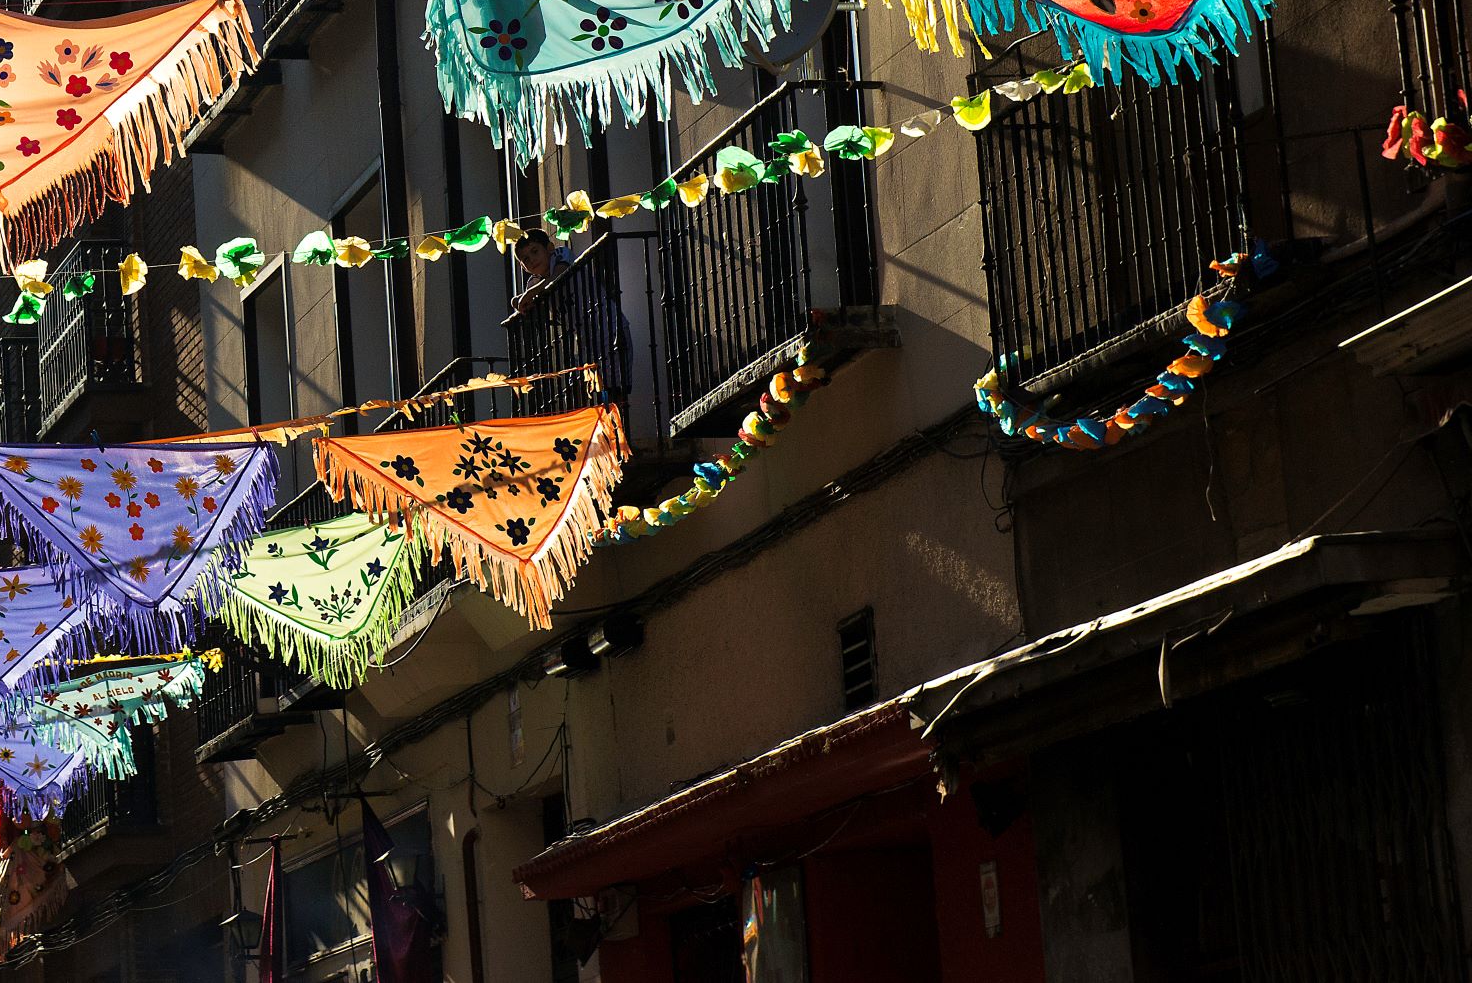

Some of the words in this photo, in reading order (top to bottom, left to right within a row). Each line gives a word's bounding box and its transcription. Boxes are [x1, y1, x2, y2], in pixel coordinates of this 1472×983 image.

[80, 677, 94, 687] DE
[95, 670, 133, 680] MADRID
[92, 693, 105, 701] AL
[106, 686, 134, 698] CIELO
